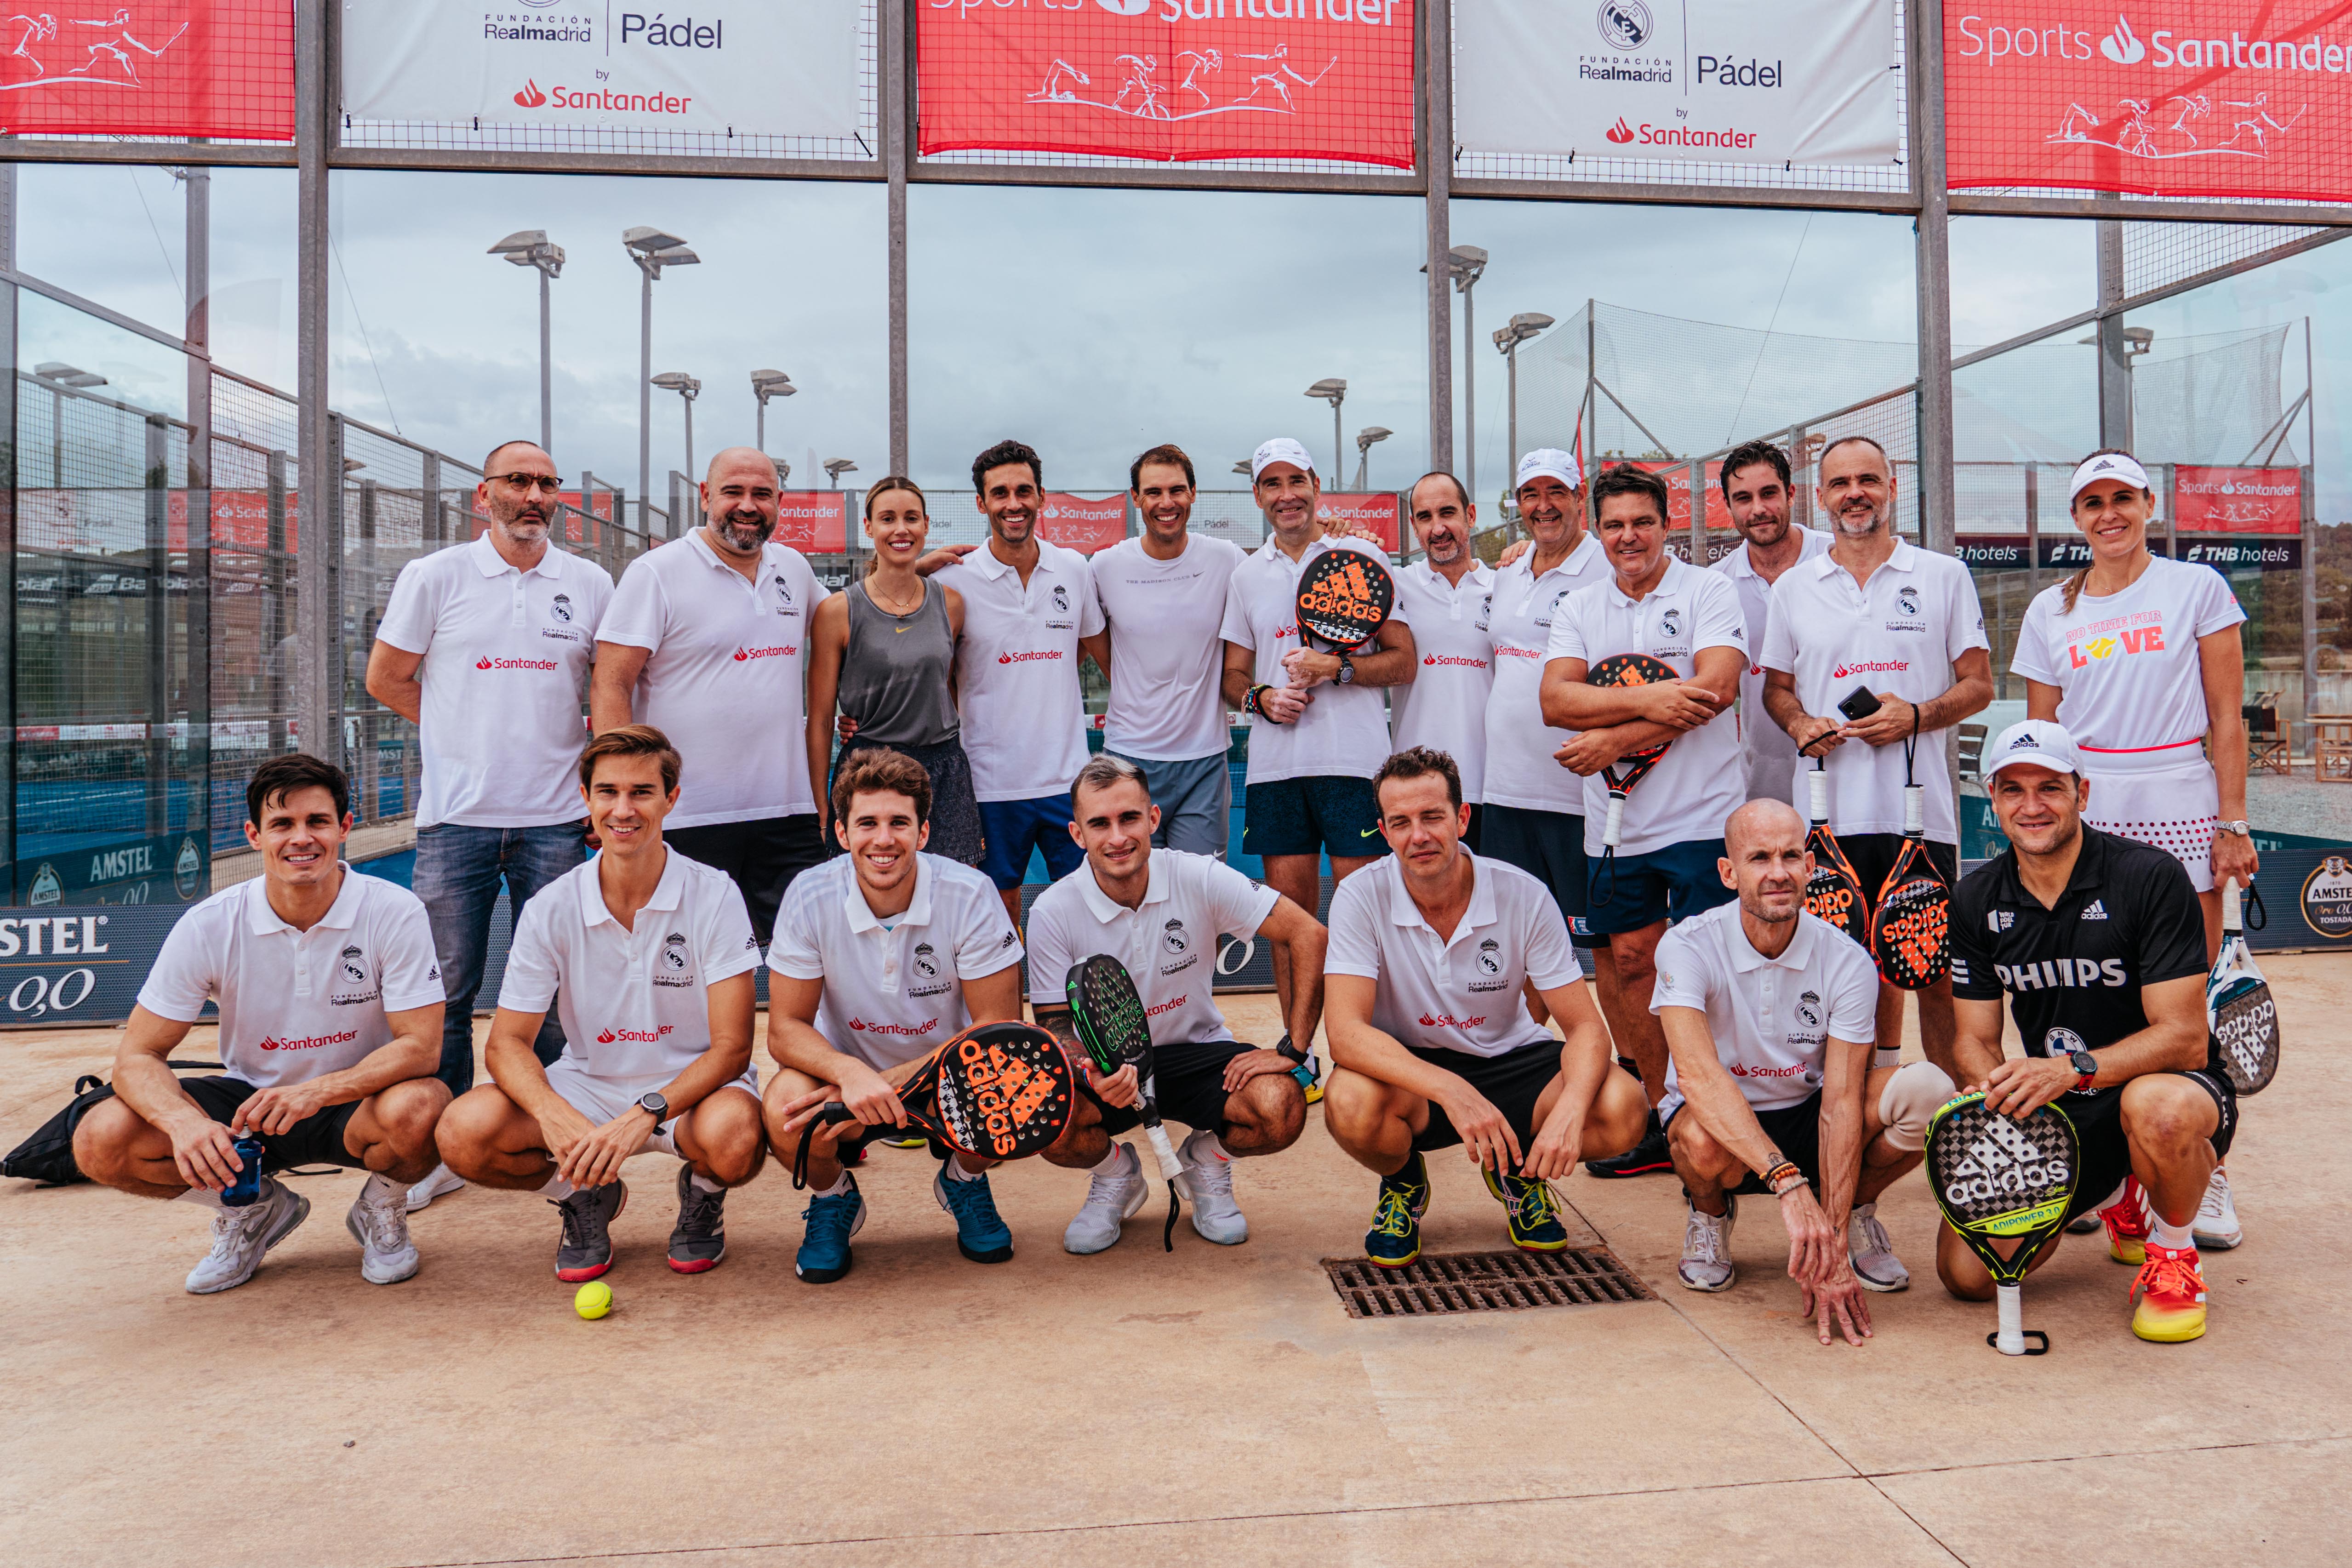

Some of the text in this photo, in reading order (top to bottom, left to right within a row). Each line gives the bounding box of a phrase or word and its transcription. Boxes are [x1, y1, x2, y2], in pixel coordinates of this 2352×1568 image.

[485, 14, 591, 24] FUNDACIÓN
[484, 24, 591, 42] Realmadrid
[622, 13, 722, 49] Pádel
[1959, 16, 2092, 67] Sports
[1580, 56, 1672, 66] FUNDACIÓN
[596, 69, 610, 81] by
[1580, 64, 1672, 83] Realmadrid
[1698, 55, 1782, 88] Pádel
[552, 86, 692, 114] Santander
[1676, 108, 1688, 119] by
[1639, 124, 1757, 148] Santander
[2179, 479, 2296, 496] Sports Santander
[781, 506, 839, 519] antander
[1061, 507, 1123, 521] Santander
[1333, 506, 1394, 519] Santander
[1204, 519, 1229, 528] Pádel
[1966, 546, 2018, 560] hotels
[2069, 546, 2094, 560] TH
[2205, 546, 2289, 561] THB hotels
[1300, 593, 1382, 622] adidas
[2066, 610, 2163, 643] NO TIME FOR
[542, 631, 578, 642] Realmadrid
[749, 644, 797, 660] Santander
[1012, 650, 1063, 662] Santander
[1499, 645, 1542, 659] Santander
[494, 657, 558, 671] Santander
[1437, 655, 1488, 668] Santander
[1849, 660, 1909, 674] Santander
[2009, 741, 2039, 750] adidas
[90, 845, 153, 882] AMSTEL
[34, 889, 58, 902] AMSTEL
[2312, 887, 2352, 900] AMSTE
[1161, 958, 1198, 977] Realmadrid
[653, 980, 693, 988] Realmadrid
[908, 981, 951, 992] FUNDACIÓN
[1468, 983, 1508, 993] Realmadrid
[9, 968, 96, 1017] 0,0
[909, 985, 952, 999] Realmadrid
[331, 995, 378, 1007] Realmadrid
[1145, 994, 1187, 1017] tander
[868, 1018, 938, 1035] Santander
[1106, 999, 1144, 1051] adidas
[280, 1030, 358, 1051] Santander
[2049, 1031, 2078, 1043] BMW
[959, 1040, 1016, 1156] adidas
[1946, 1157, 2069, 1205] adidas
[1992, 1206, 2061, 1232] ADIPOWER 3.0
